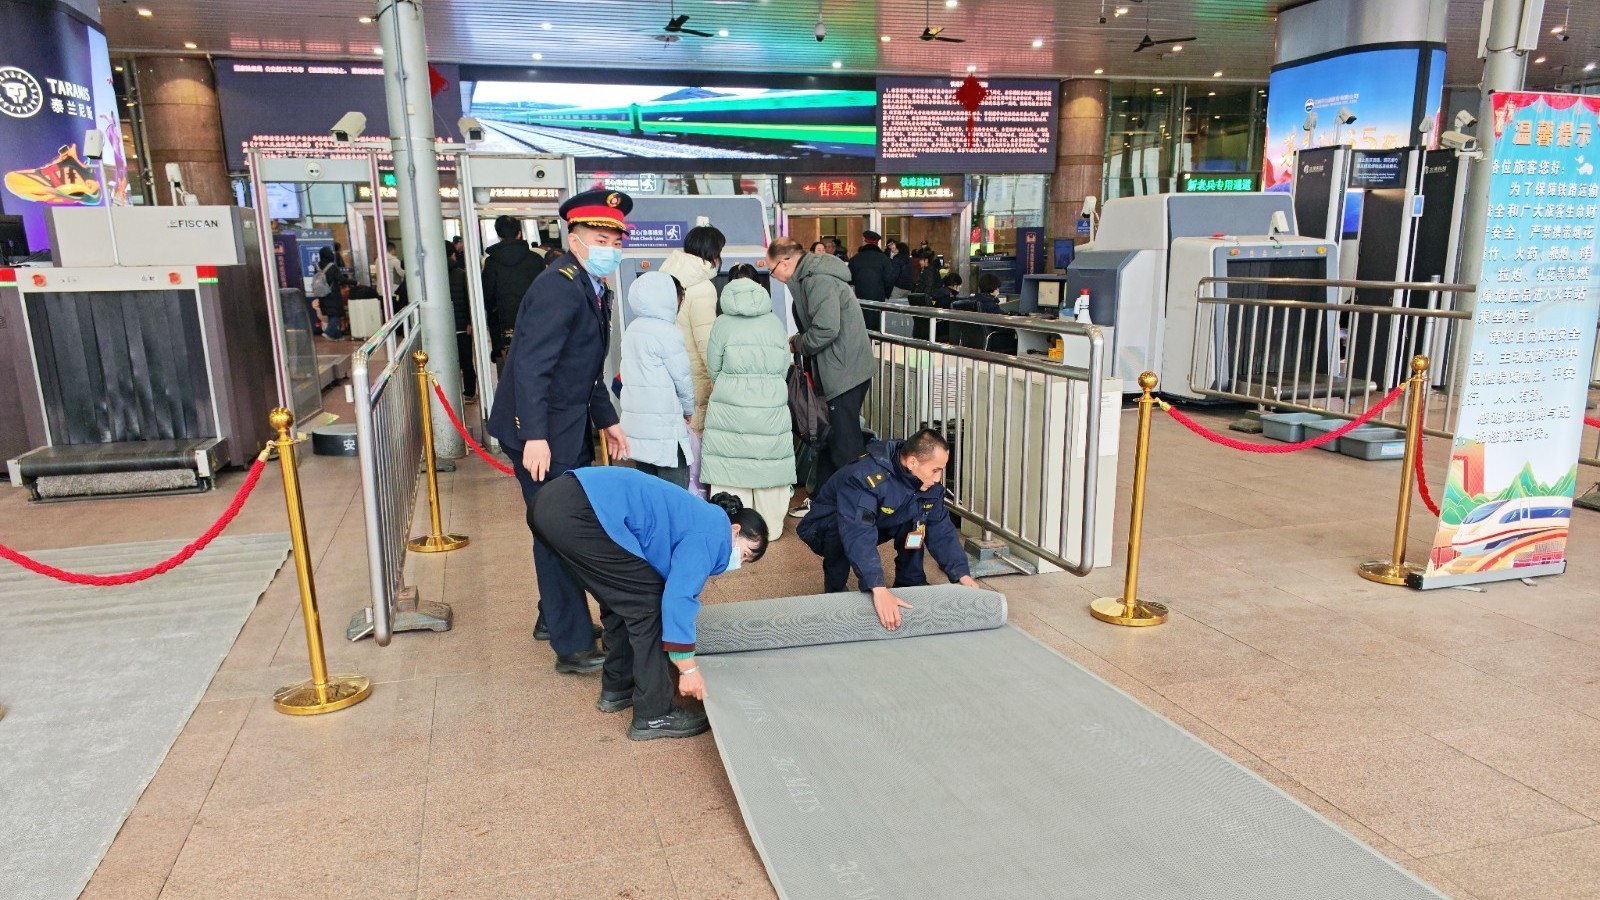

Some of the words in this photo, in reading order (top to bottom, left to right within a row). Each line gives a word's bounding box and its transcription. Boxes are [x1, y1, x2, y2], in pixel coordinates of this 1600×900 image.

[46, 78, 91, 102] TARANIS
[51, 98, 94, 120] 泰兰尼斯
[1512, 120, 1592, 148] 温馨提示
[819, 182, 857, 196] 售票处
[900, 177, 940, 187] 铁路进站口
[1187, 178, 1252, 191] 新老兵专用通道
[1508, 181, 1600, 199] 为了保障铁路运输
[178, 219, 219, 228] FISCAN
[1483, 246, 1593, 262] 竹、火药、鞭炮、摔
[343, 439, 355, 451] 安
